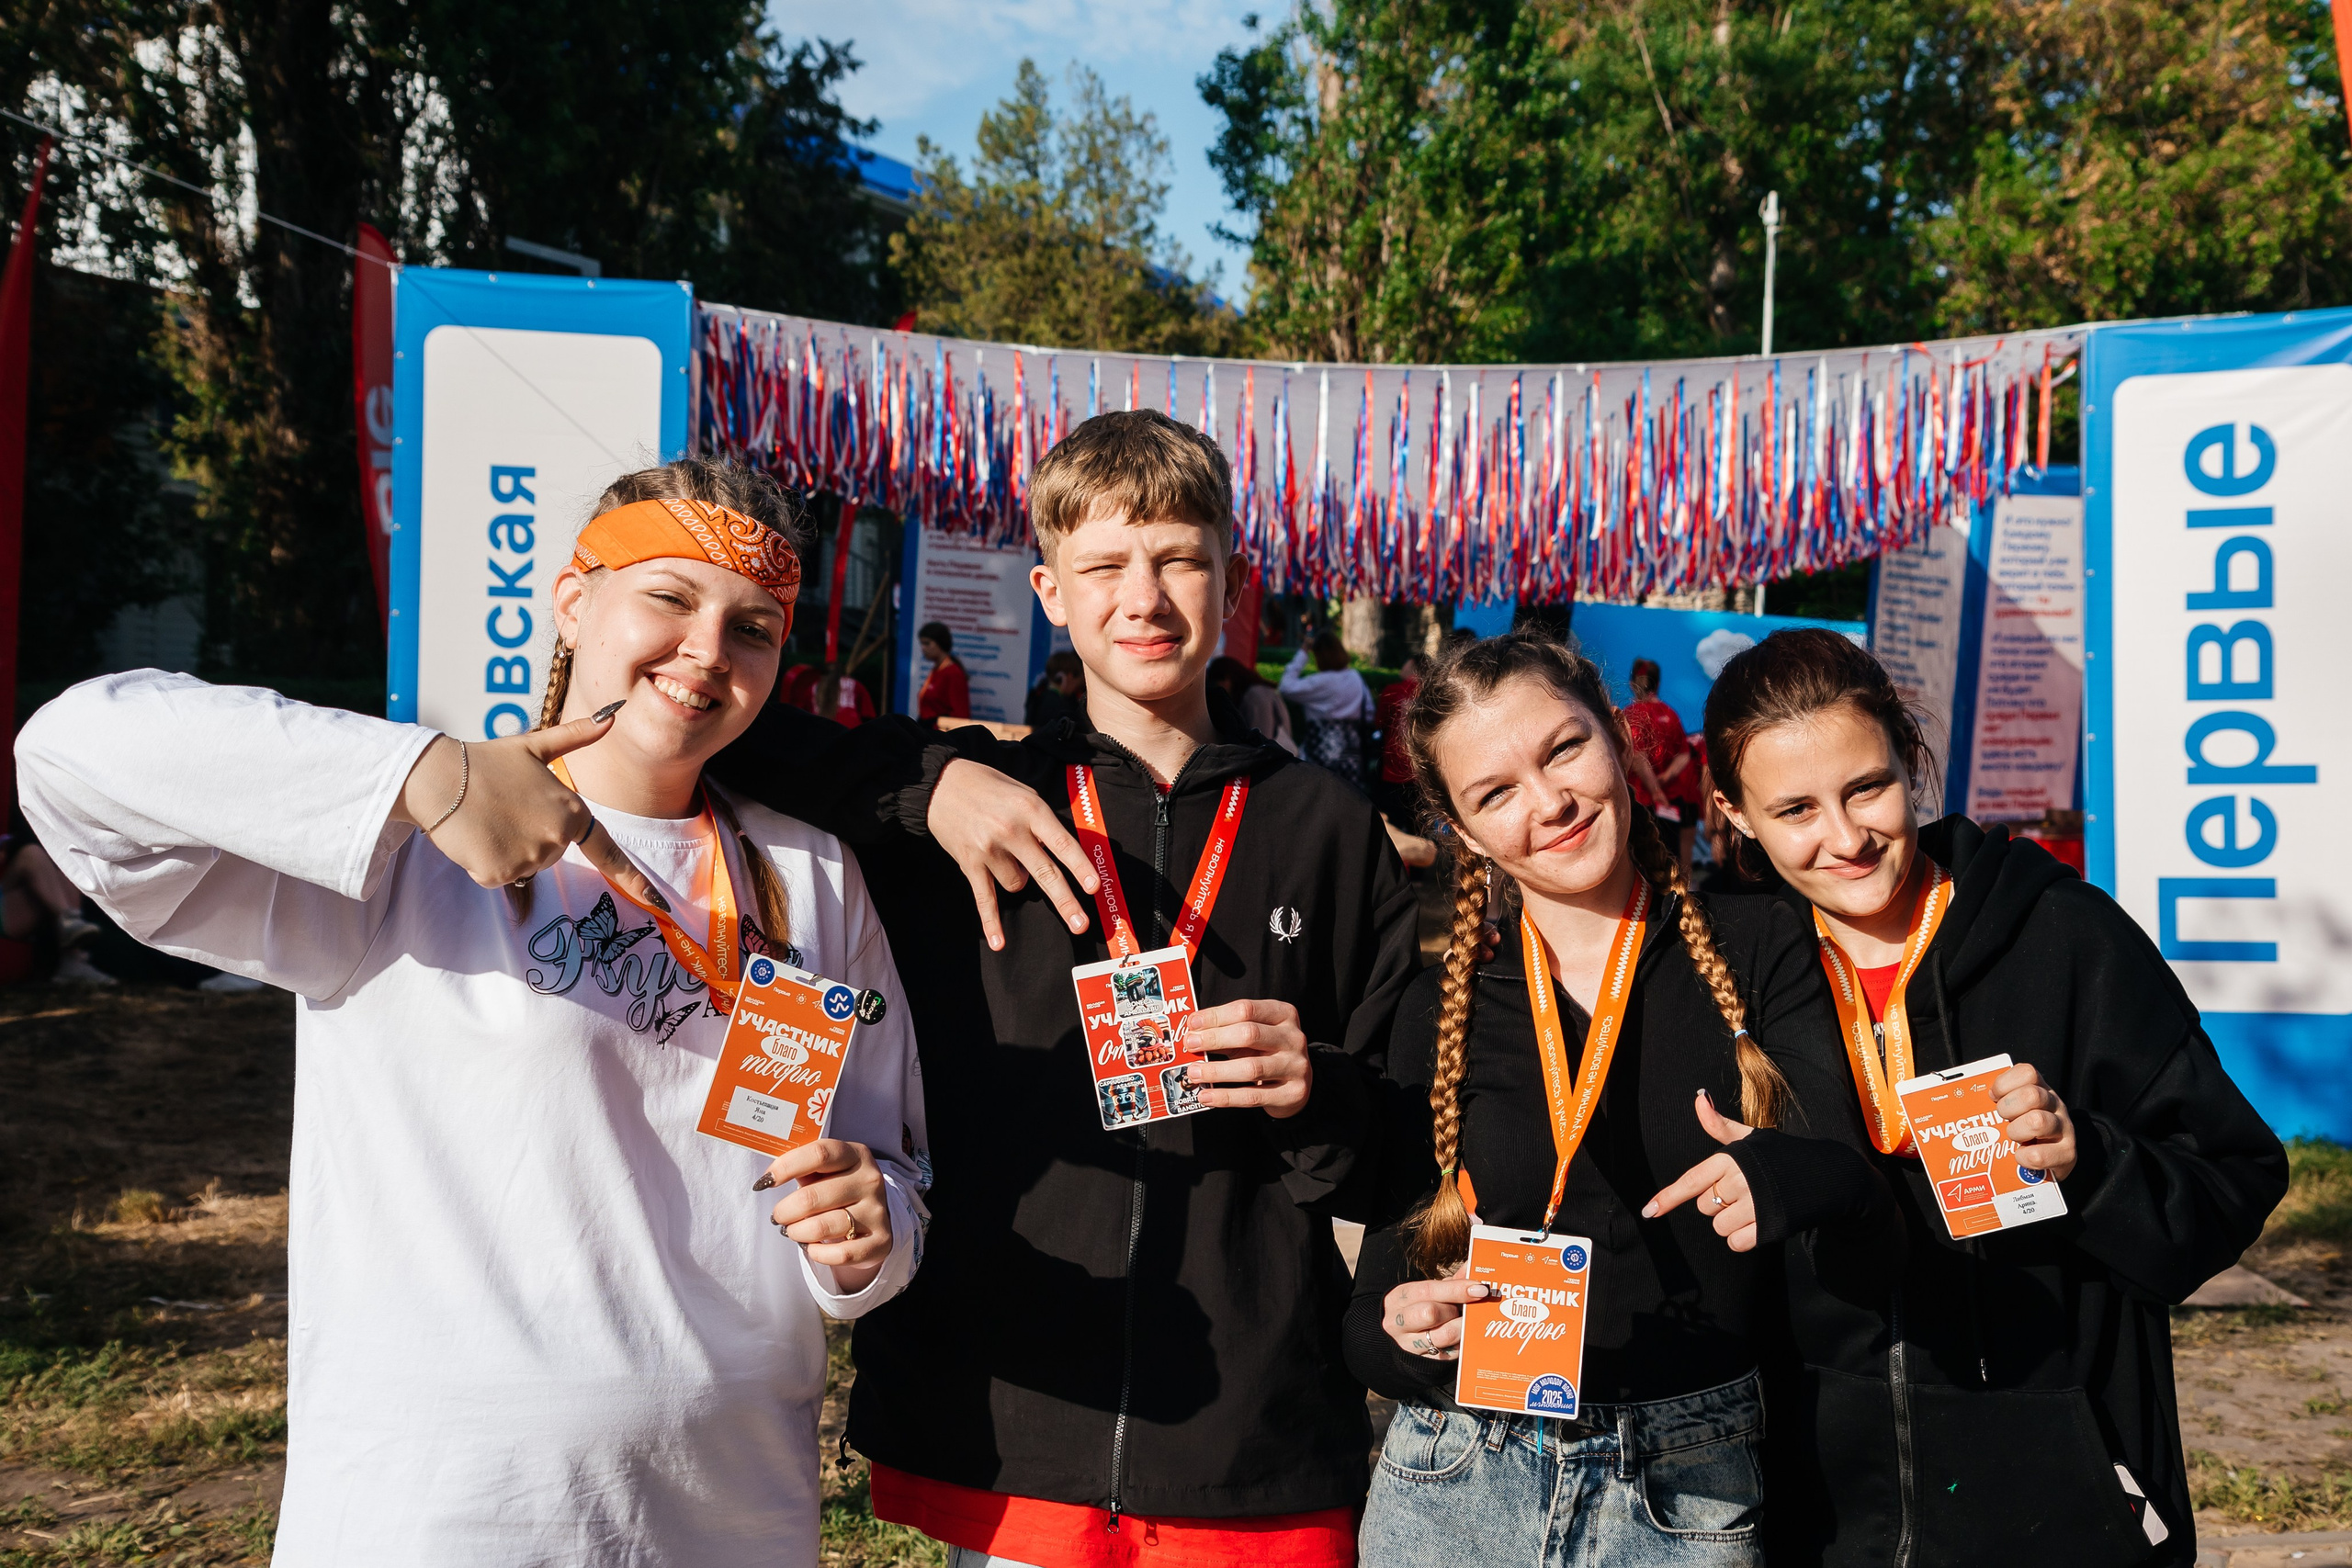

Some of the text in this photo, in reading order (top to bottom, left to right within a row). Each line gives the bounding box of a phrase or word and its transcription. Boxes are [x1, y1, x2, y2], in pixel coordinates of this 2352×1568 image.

[483, 465, 536, 740] овская
[2157, 422, 2318, 964] Первые
[1212, 837, 1226, 854] не
[1188, 853, 1221, 920] волнуйтесь
[717, 896, 727, 913] не
[1111, 915, 1123, 931] не
[1088, 996, 1192, 1030] УЧАИК
[738, 1009, 842, 1058] УЧАСТНИК
[1544, 1026, 1555, 1042] не
[1589, 1015, 1614, 1072] волнуйтесь
[1890, 1004, 1907, 1081] не волнуйте
[771, 1038, 797, 1060] благо
[739, 1055, 822, 1095] творю
[1546, 1042, 1564, 1098] волнуйтесь
[1586, 1070, 1598, 1085] не
[1174, 1095, 1198, 1106] BOBRIT
[752, 1114, 764, 1123] 4/20
[1962, 1131, 1989, 1147] благо
[1963, 1185, 1985, 1195] АРМИ
[2022, 1207, 2035, 1215] 4/20
[1481, 1280, 1580, 1308] ЧАСТНИК
[1511, 1299, 1537, 1318] благо
[1485, 1319, 1566, 1356] творю
[1542, 1389, 1563, 1404] 2025
